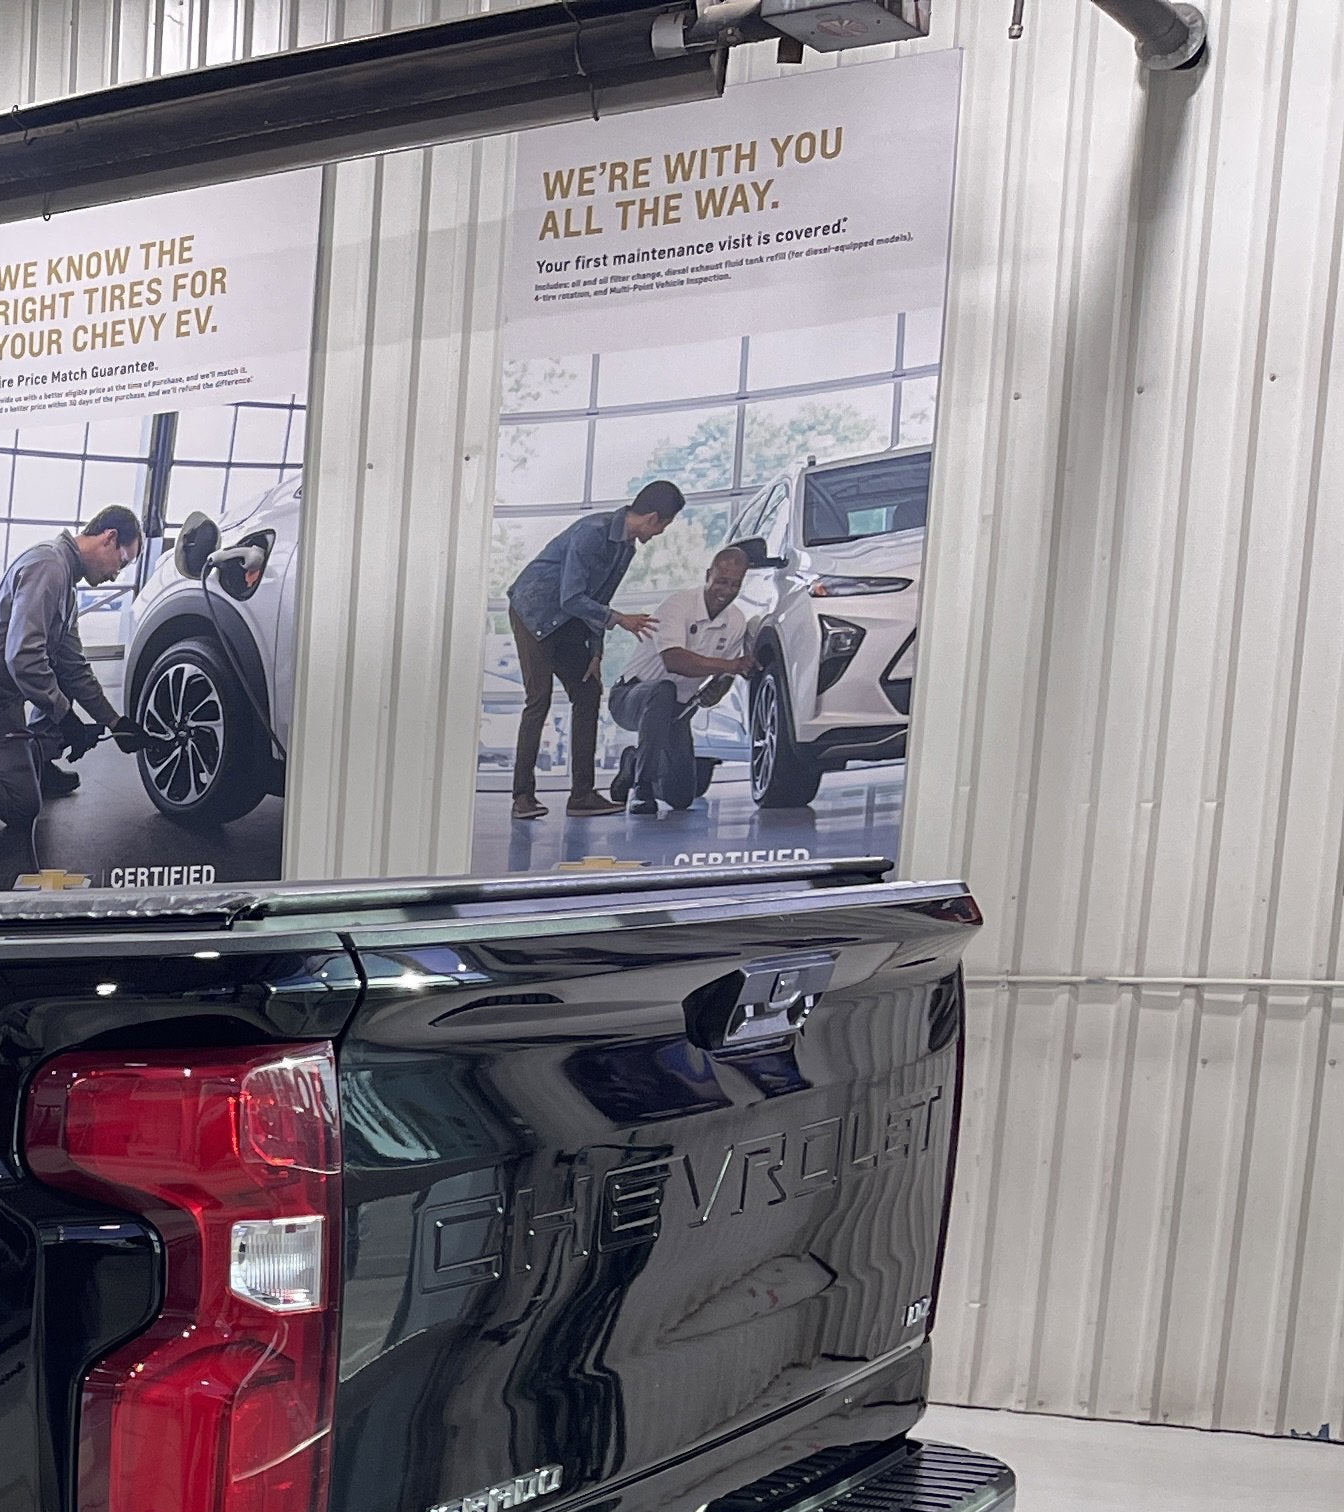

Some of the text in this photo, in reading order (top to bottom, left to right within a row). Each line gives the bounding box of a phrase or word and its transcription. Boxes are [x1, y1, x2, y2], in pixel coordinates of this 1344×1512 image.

[542, 126, 844, 202] WE'RE WITH YOU
[538, 178, 780, 241] ALL THE WAY.
[46, 245, 132, 286] KNOW
[139, 235, 195, 271] THE
[534, 281, 571, 292] Includes:
[571, 279, 581, 288] oil
[582, 277, 597, 287] and
[599, 276, 609, 286] oil
[610, 274, 631, 284] filter
[664, 265, 689, 277] diesel
[690, 261, 724, 273] exhaust
[724, 258, 744, 268] fluid
[745, 256, 764, 266] tank
[765, 251, 787, 263] refill
[805, 238, 875, 257] diesel-equipped
[536, 259, 571, 274] Your
[574, 252, 609, 270] first
[612, 240, 715, 266] maintenance
[718, 233, 753, 251] visit
[757, 230, 770, 246] is
[83, 277, 163, 315] TIRES
[172, 266, 228, 302] FOR
[593, 287, 608, 297] and
[609, 282, 654, 296] Multi-Point
[655, 278, 685, 290] Vehicle
[72, 311, 167, 353] CHEVY
[175, 304, 218, 338] EV.
[9, 404, 30, 413] better
[30, 404, 47, 413] price
[47, 401, 68, 410] within
[78, 397, 93, 407] days
[94, 396, 102, 404] of
[102, 395, 113, 403] the
[147, 388, 161, 398] and
[178, 382, 201, 394] refund
[202, 381, 214, 390] the
[17, 372, 48, 387] Price
[51, 367, 88, 384] Match
[91, 360, 159, 378] Guarantee.
[23, 393, 38, 402] with
[43, 391, 64, 400] better
[65, 388, 88, 400] eligible
[89, 386, 106, 396] price
[106, 385, 114, 393] at
[115, 383, 127, 391] the
[127, 381, 142, 390] time
[143, 379, 151, 388] of
[151, 376, 185, 389] purchase,
[186, 373, 199, 382] and
[216, 367, 239, 378] match
[110, 864, 216, 889] CERTIFIED
[418, 1084, 944, 1295] CHEVROLET
